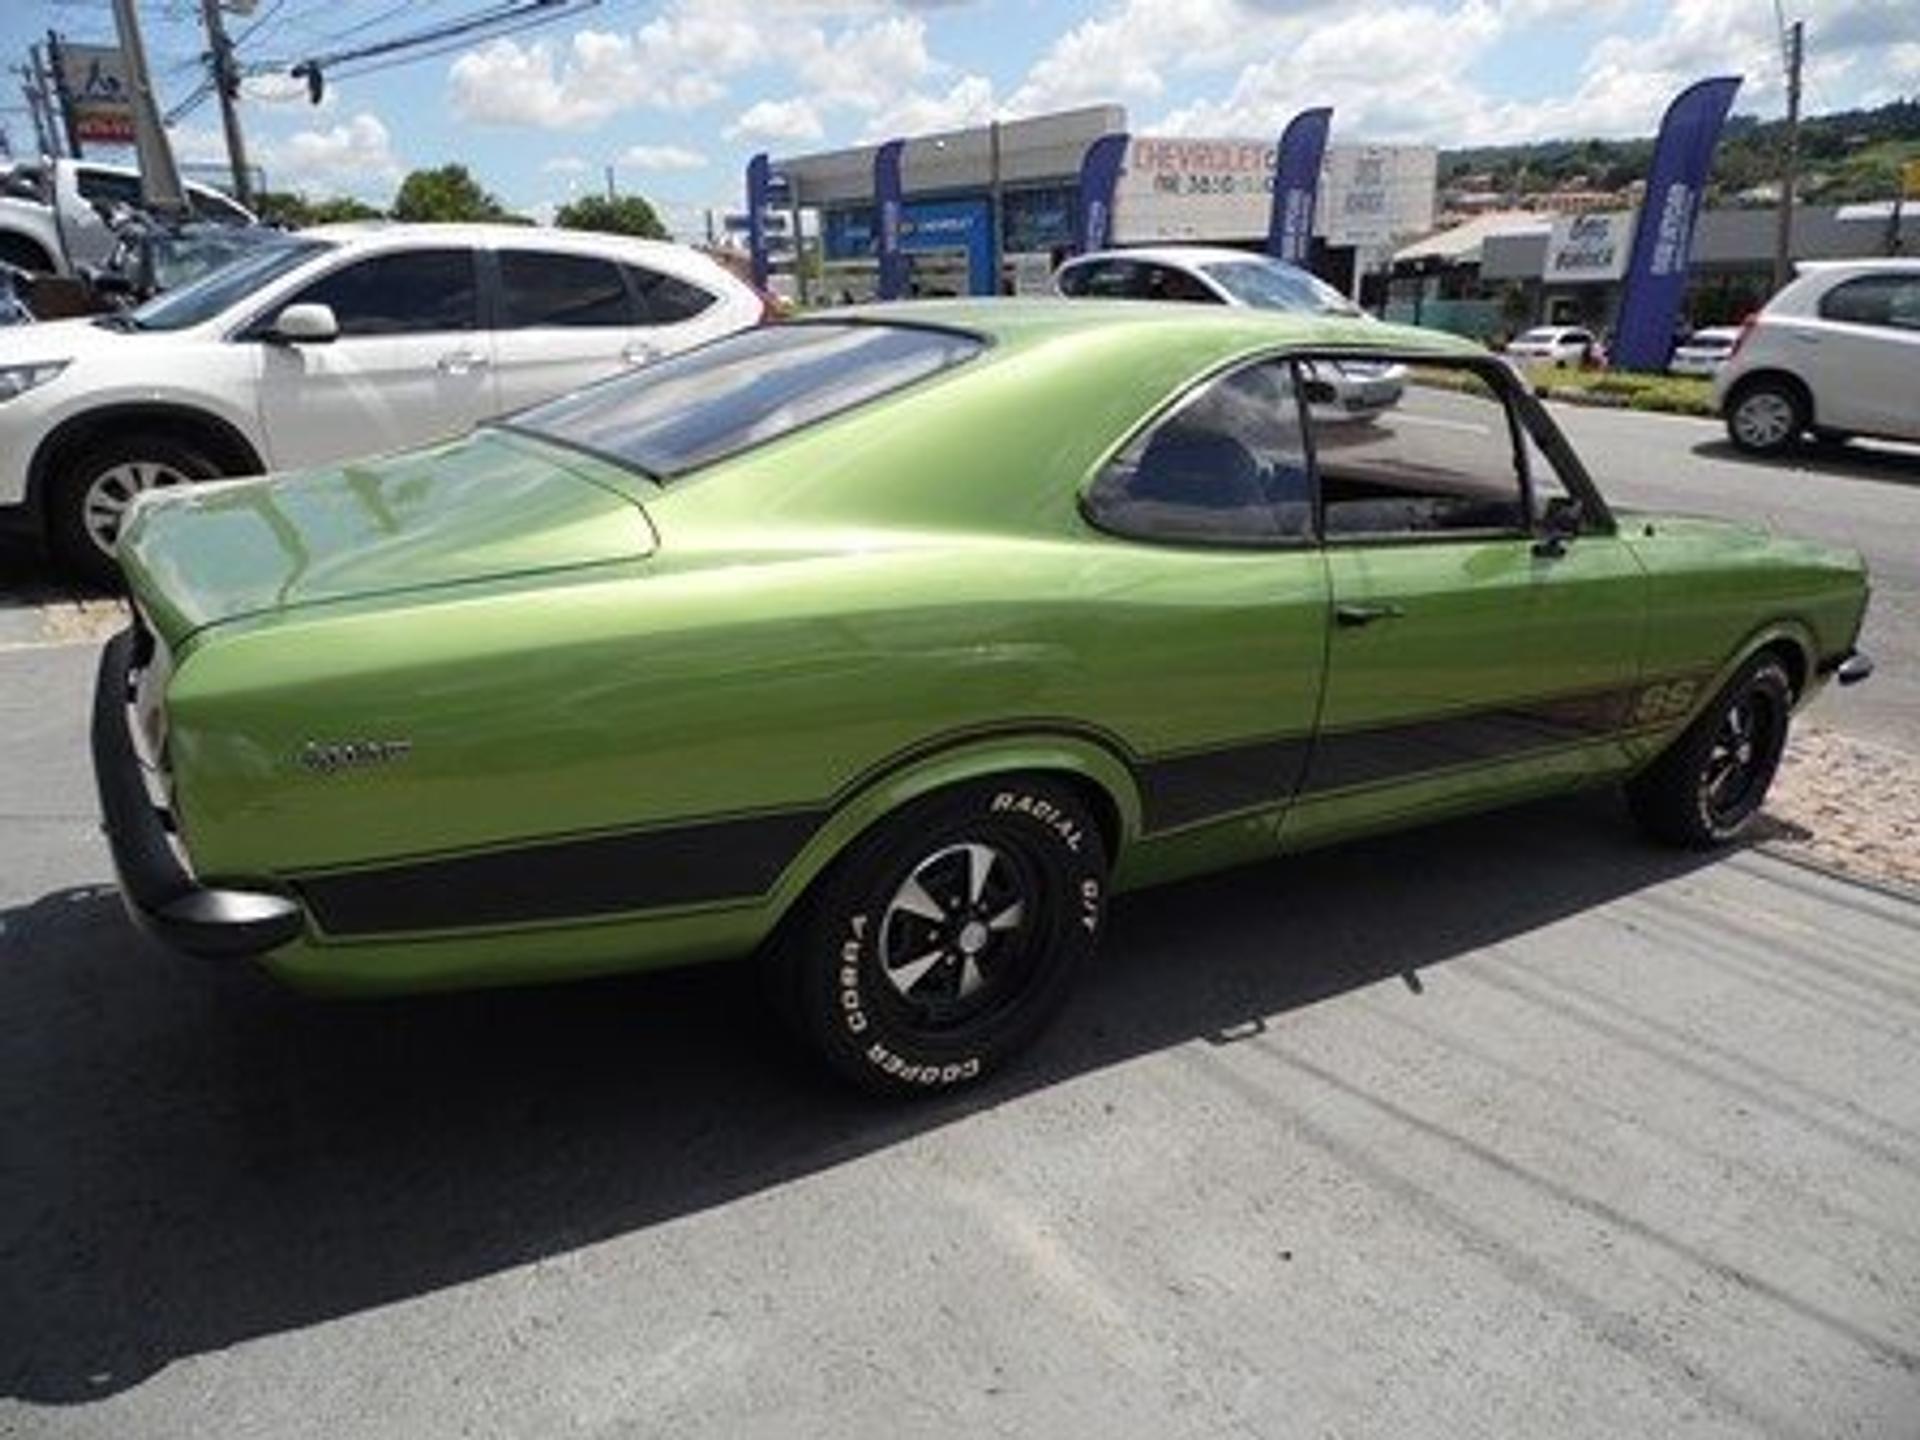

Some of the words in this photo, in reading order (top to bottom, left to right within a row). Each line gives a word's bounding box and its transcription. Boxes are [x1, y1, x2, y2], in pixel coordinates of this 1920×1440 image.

[990, 792, 1084, 852] RADIAL
[839, 913, 869, 1035] COBRA
[866, 1042, 981, 1084] COOPER
